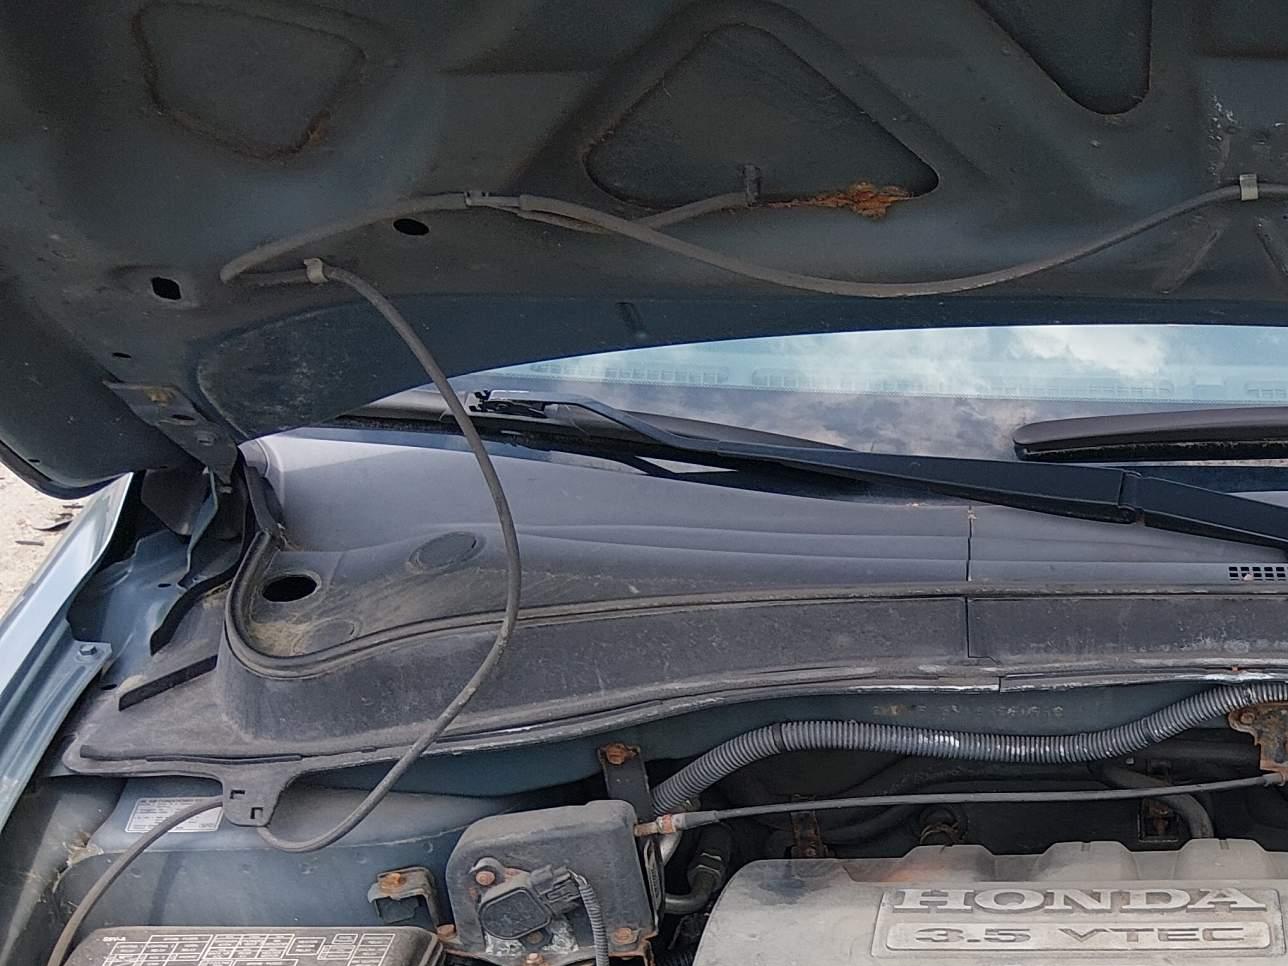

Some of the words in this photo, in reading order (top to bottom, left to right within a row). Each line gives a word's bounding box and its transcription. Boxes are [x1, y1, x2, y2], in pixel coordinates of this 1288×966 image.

[893, 889, 1267, 913] HONDA
[915, 927, 1032, 943] 3.5
[1058, 927, 1245, 943] VTEC
